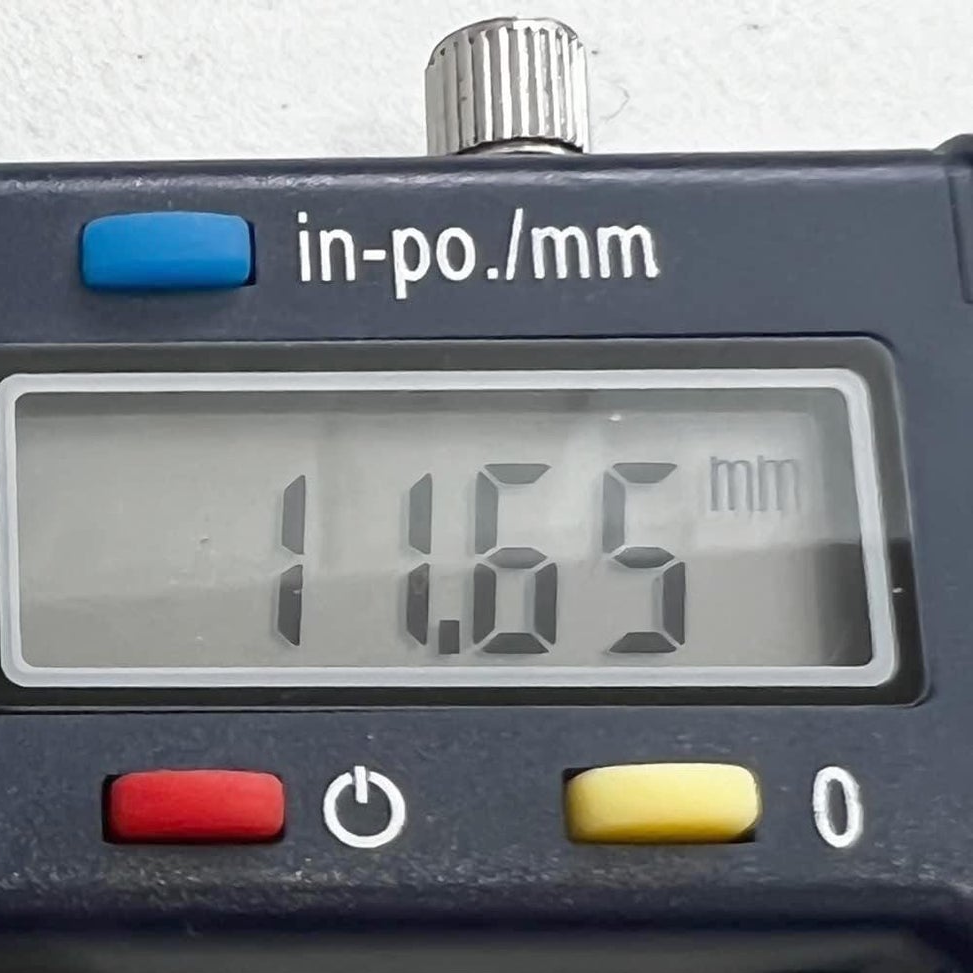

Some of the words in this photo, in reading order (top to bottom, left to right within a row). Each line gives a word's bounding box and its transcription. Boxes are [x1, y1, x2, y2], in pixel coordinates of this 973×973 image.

[297, 208, 661, 299] in-po./mm
[276, 463, 687, 655] 11.65
[708, 456, 802, 513] mm
[811, 765, 864, 849] 0
